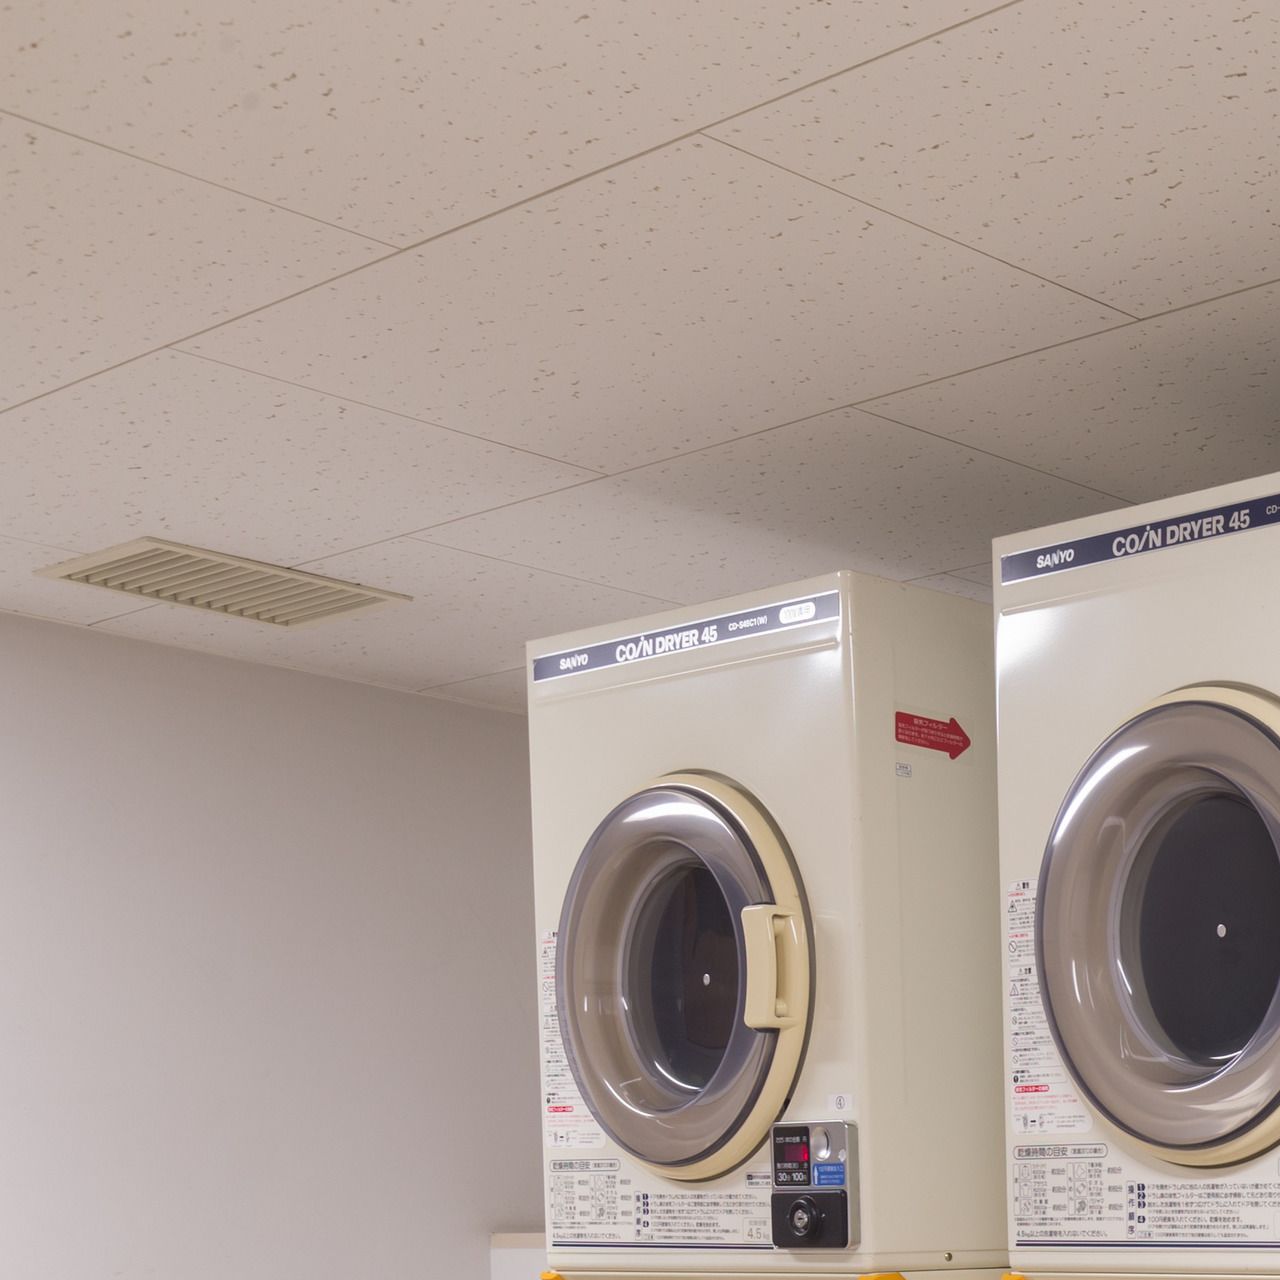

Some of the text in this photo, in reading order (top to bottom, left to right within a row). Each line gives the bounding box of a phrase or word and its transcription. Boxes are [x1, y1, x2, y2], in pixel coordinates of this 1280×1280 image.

[1036, 549, 1075, 569] SANYO
[1166, 518, 1225, 547] DRYER
[1229, 509, 1250, 530] 45
[559, 653, 588, 670] SANYO
[656, 629, 699, 653] DRYER
[701, 625, 718, 643] 45
